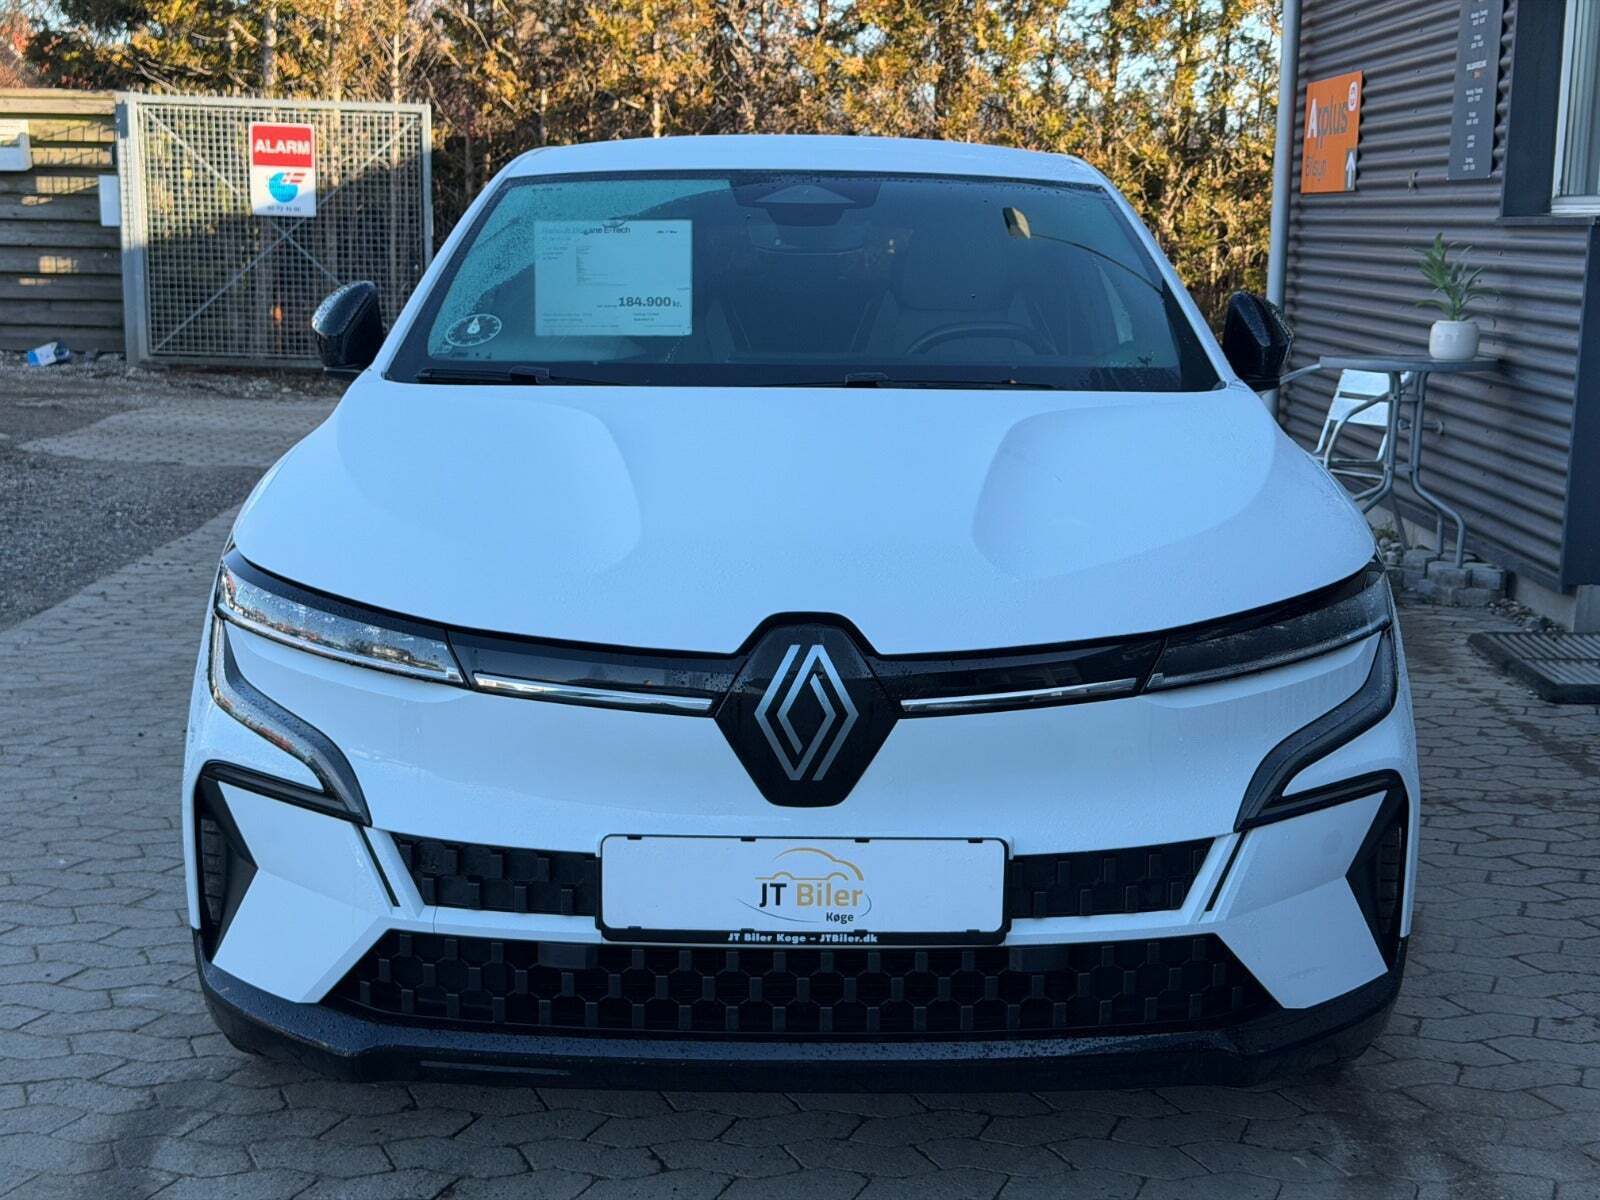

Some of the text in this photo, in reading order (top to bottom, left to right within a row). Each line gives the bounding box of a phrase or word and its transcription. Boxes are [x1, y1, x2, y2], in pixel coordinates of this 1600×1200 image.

[255, 138, 310, 155] ALARM
[618, 296, 671, 308] 184.900
[759, 881, 862, 907] JT Biler
[826, 912, 854, 924] Køge
[728, 933, 740, 942] JT
[744, 933, 772, 942] Biler
[820, 933, 878, 943] JTBiler.dk
